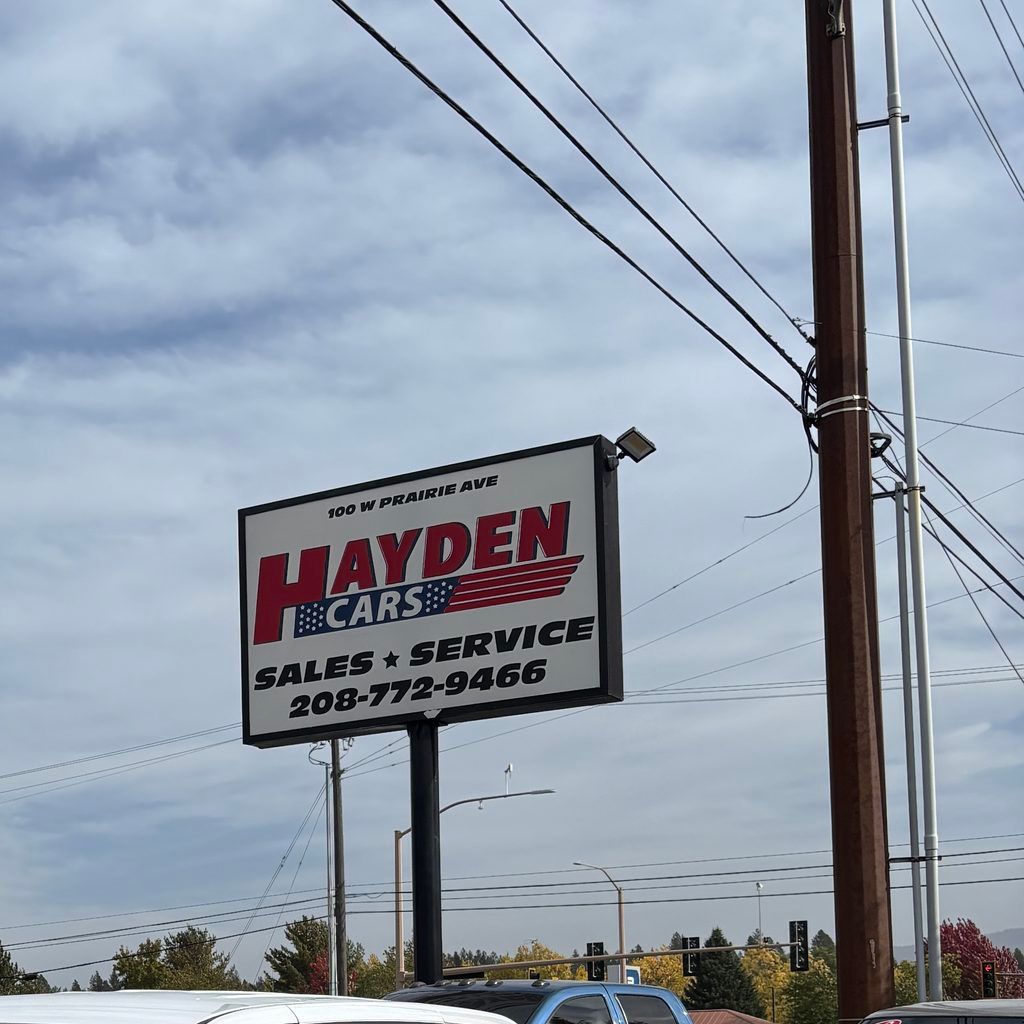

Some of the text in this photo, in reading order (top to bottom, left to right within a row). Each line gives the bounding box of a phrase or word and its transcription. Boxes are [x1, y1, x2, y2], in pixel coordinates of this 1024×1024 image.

[328, 475, 499, 518] 100 W PRAIRIE AVE
[253, 501, 570, 645] HAYDEN
[325, 585, 425, 629] CARS
[254, 616, 596, 691] SALES SERVICE
[289, 659, 548, 718] 208-772-9466
